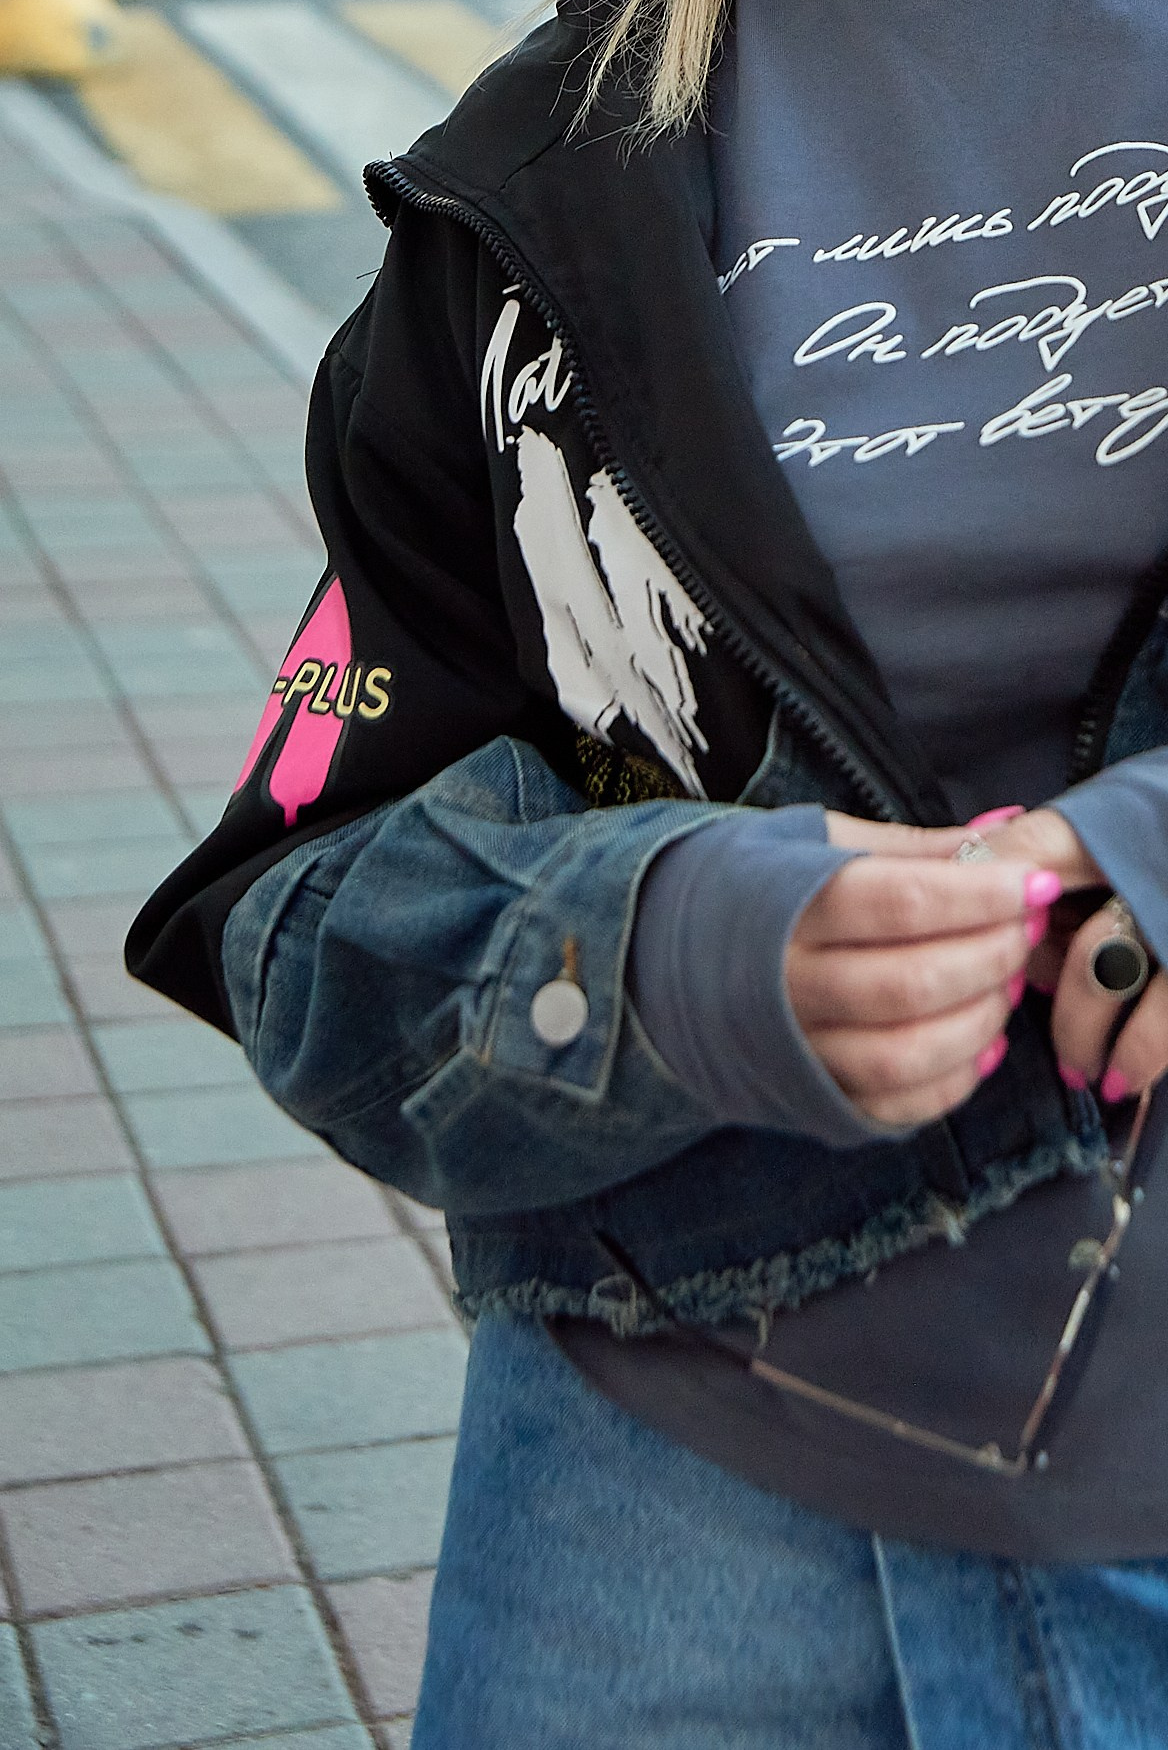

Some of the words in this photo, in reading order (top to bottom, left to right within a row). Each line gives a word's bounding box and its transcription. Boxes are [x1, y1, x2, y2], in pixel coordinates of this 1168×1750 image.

[813, 207, 1013, 263] лишь
[793, 300, 906, 367] Он
[772, 418, 965, 467] Этот
